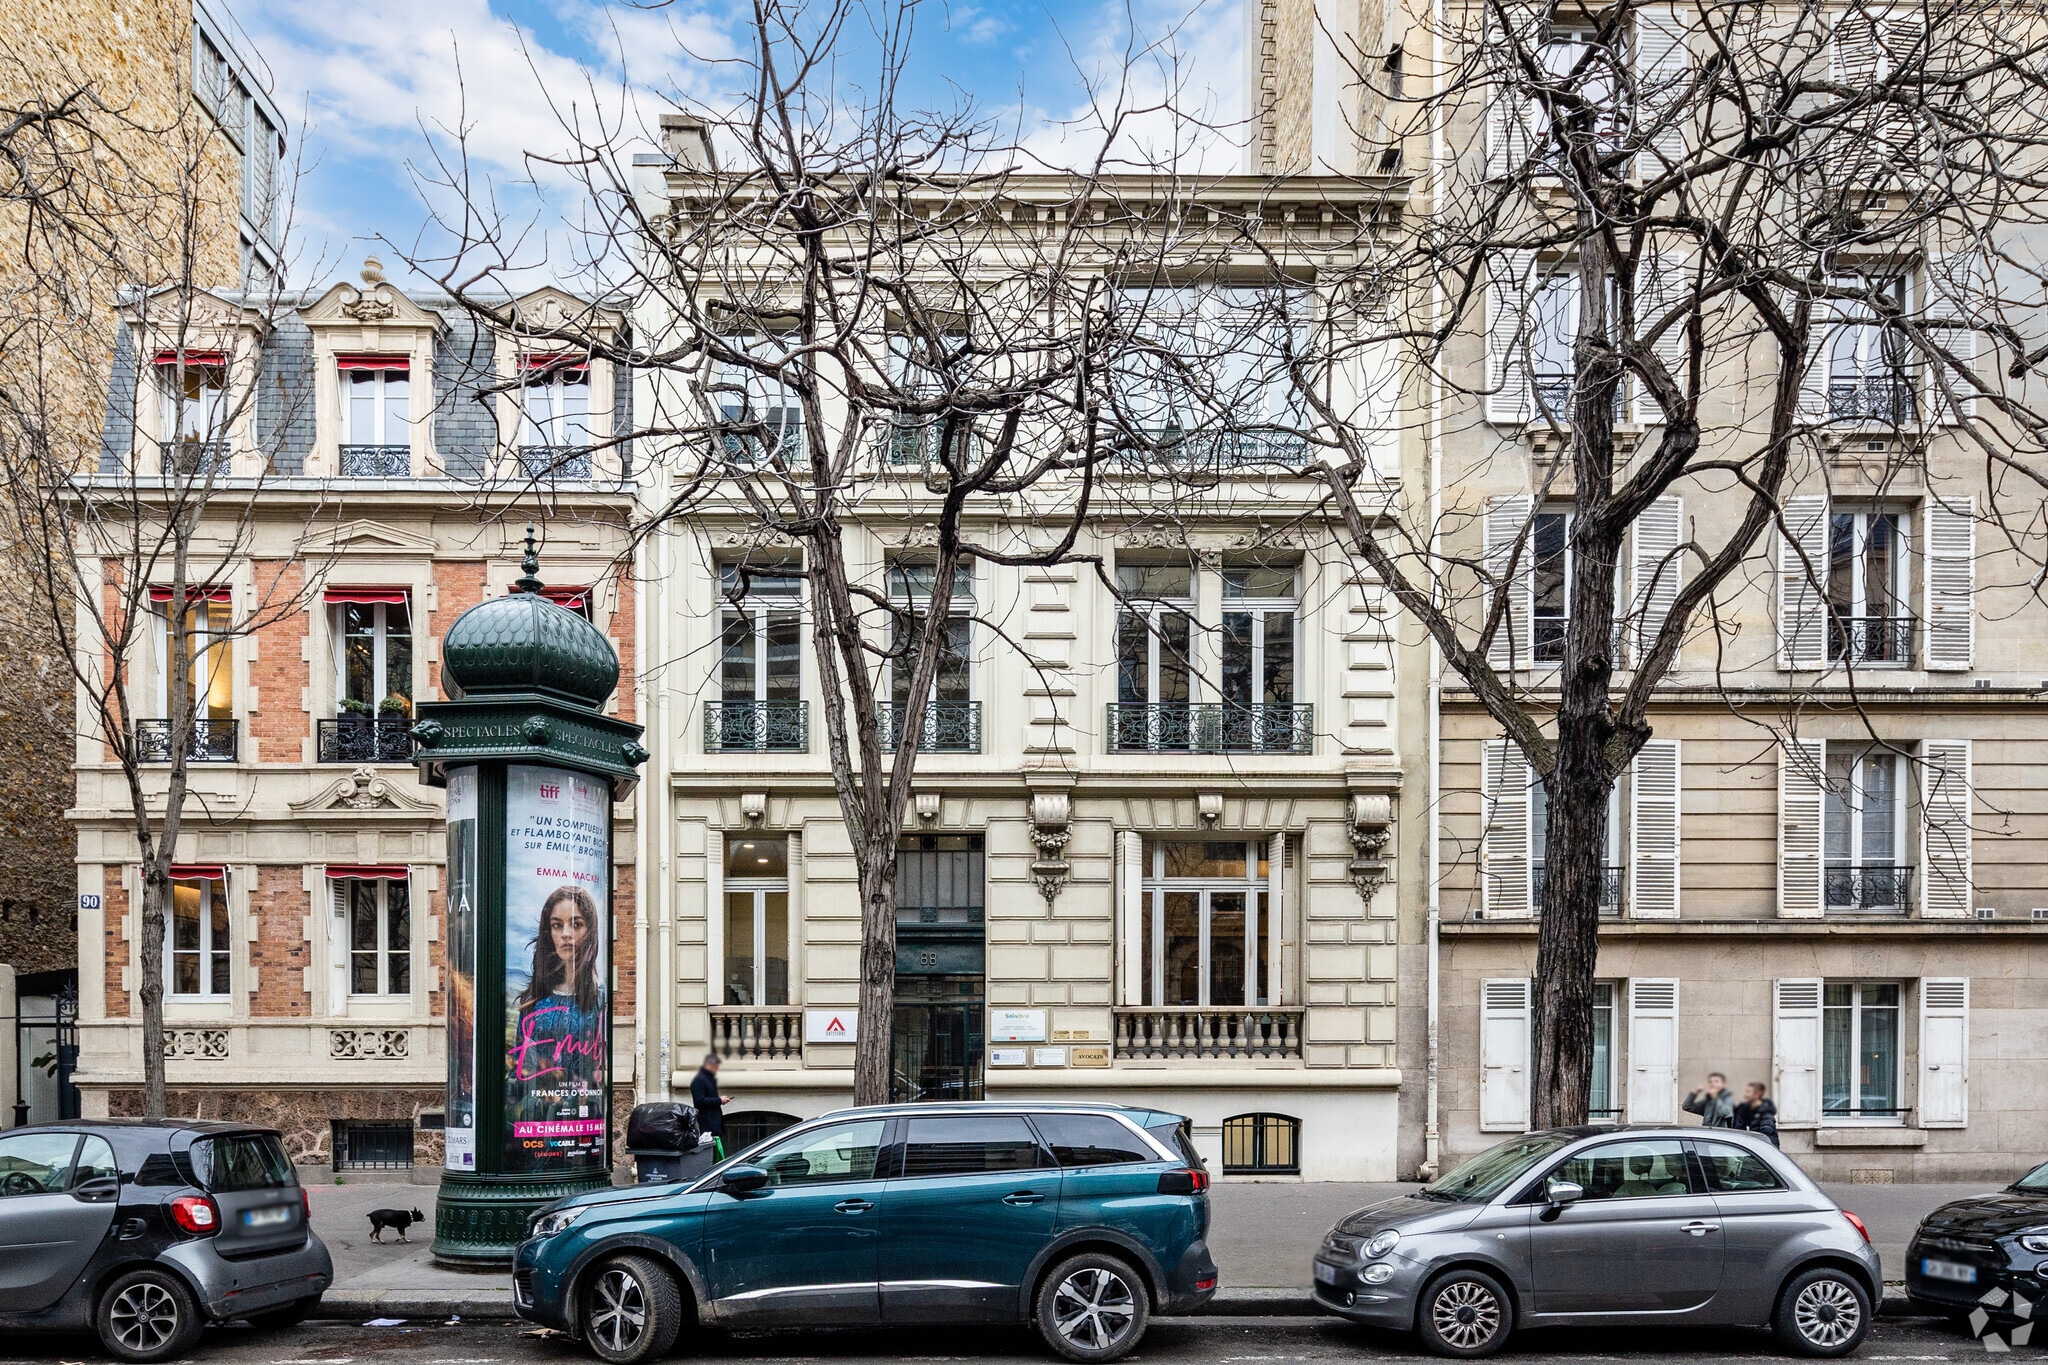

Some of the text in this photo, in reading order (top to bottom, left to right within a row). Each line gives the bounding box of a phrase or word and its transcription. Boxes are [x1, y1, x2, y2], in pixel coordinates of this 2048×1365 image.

[443, 725, 520, 738] SPECTACLES
[555, 729, 621, 755] SPECTACLES
[540, 785, 560, 799] tiff
[511, 828, 521, 836] ET
[524, 827, 592, 844] FLAMBOYANT
[524, 841, 542, 849] SUR
[546, 841, 576, 853] EMILY
[536, 867, 568, 878] EMMA
[82, 896, 98, 908] 90
[920, 952, 937, 965] 88
[558, 1081, 568, 1089] UN
[569, 1081, 581, 1089] FILM
[531, 1089, 569, 1097] FRANCES
[519, 1125, 533, 1134] AU
[536, 1123, 574, 1134] CINÉMA
[575, 1124, 584, 1132] LE
[586, 1123, 593, 1131] 15
[523, 1141, 544, 1149] OCS
[549, 1139, 576, 1147] VOCABLE
